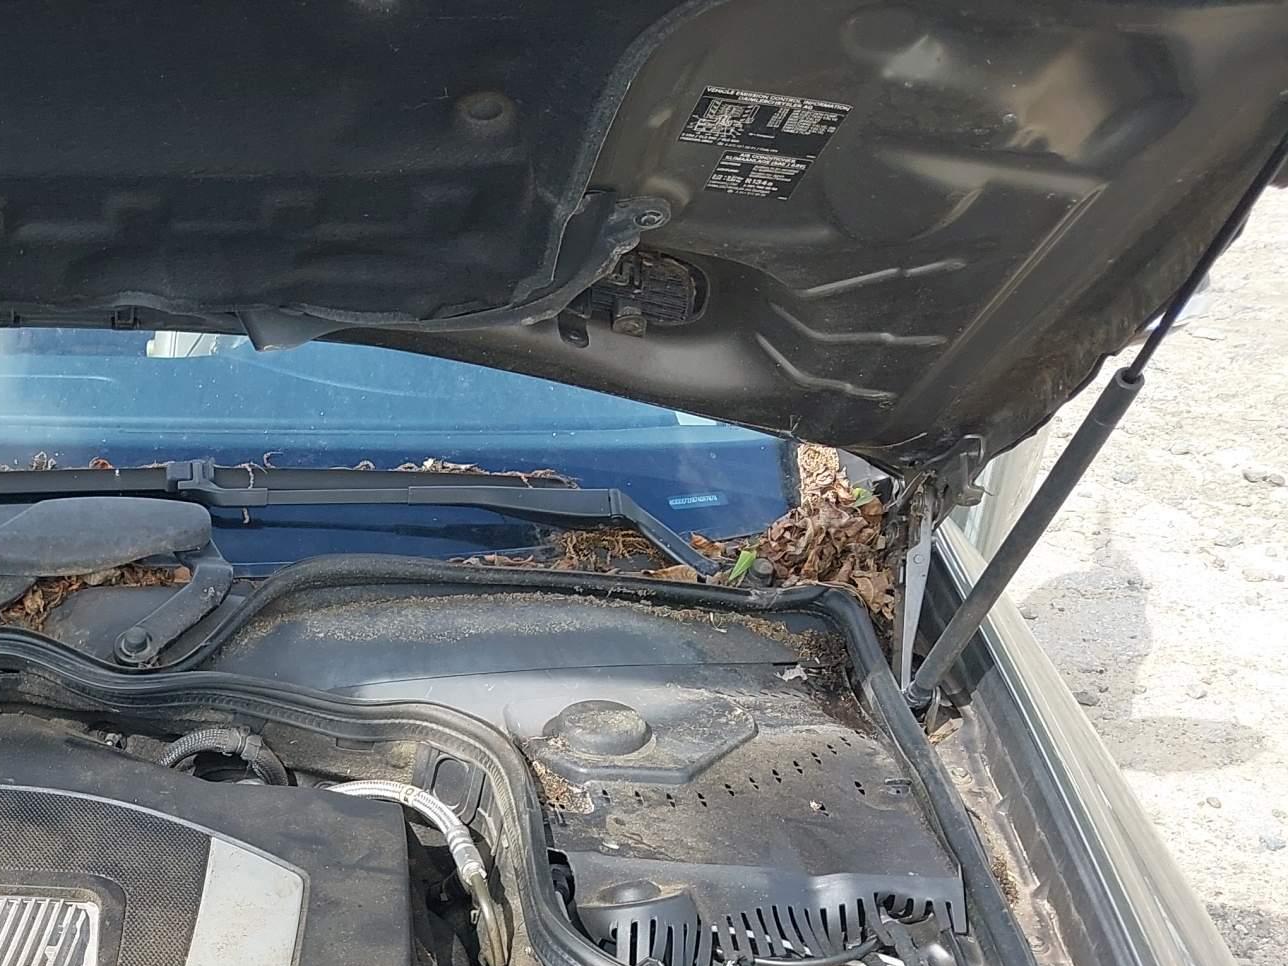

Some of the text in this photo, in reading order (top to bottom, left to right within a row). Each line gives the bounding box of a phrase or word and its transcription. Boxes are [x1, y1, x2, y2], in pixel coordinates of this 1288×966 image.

[706, 87, 851, 112] VEHICLE EMISSION CONTROL INFORMATION
[744, 178, 774, 187] R134a
